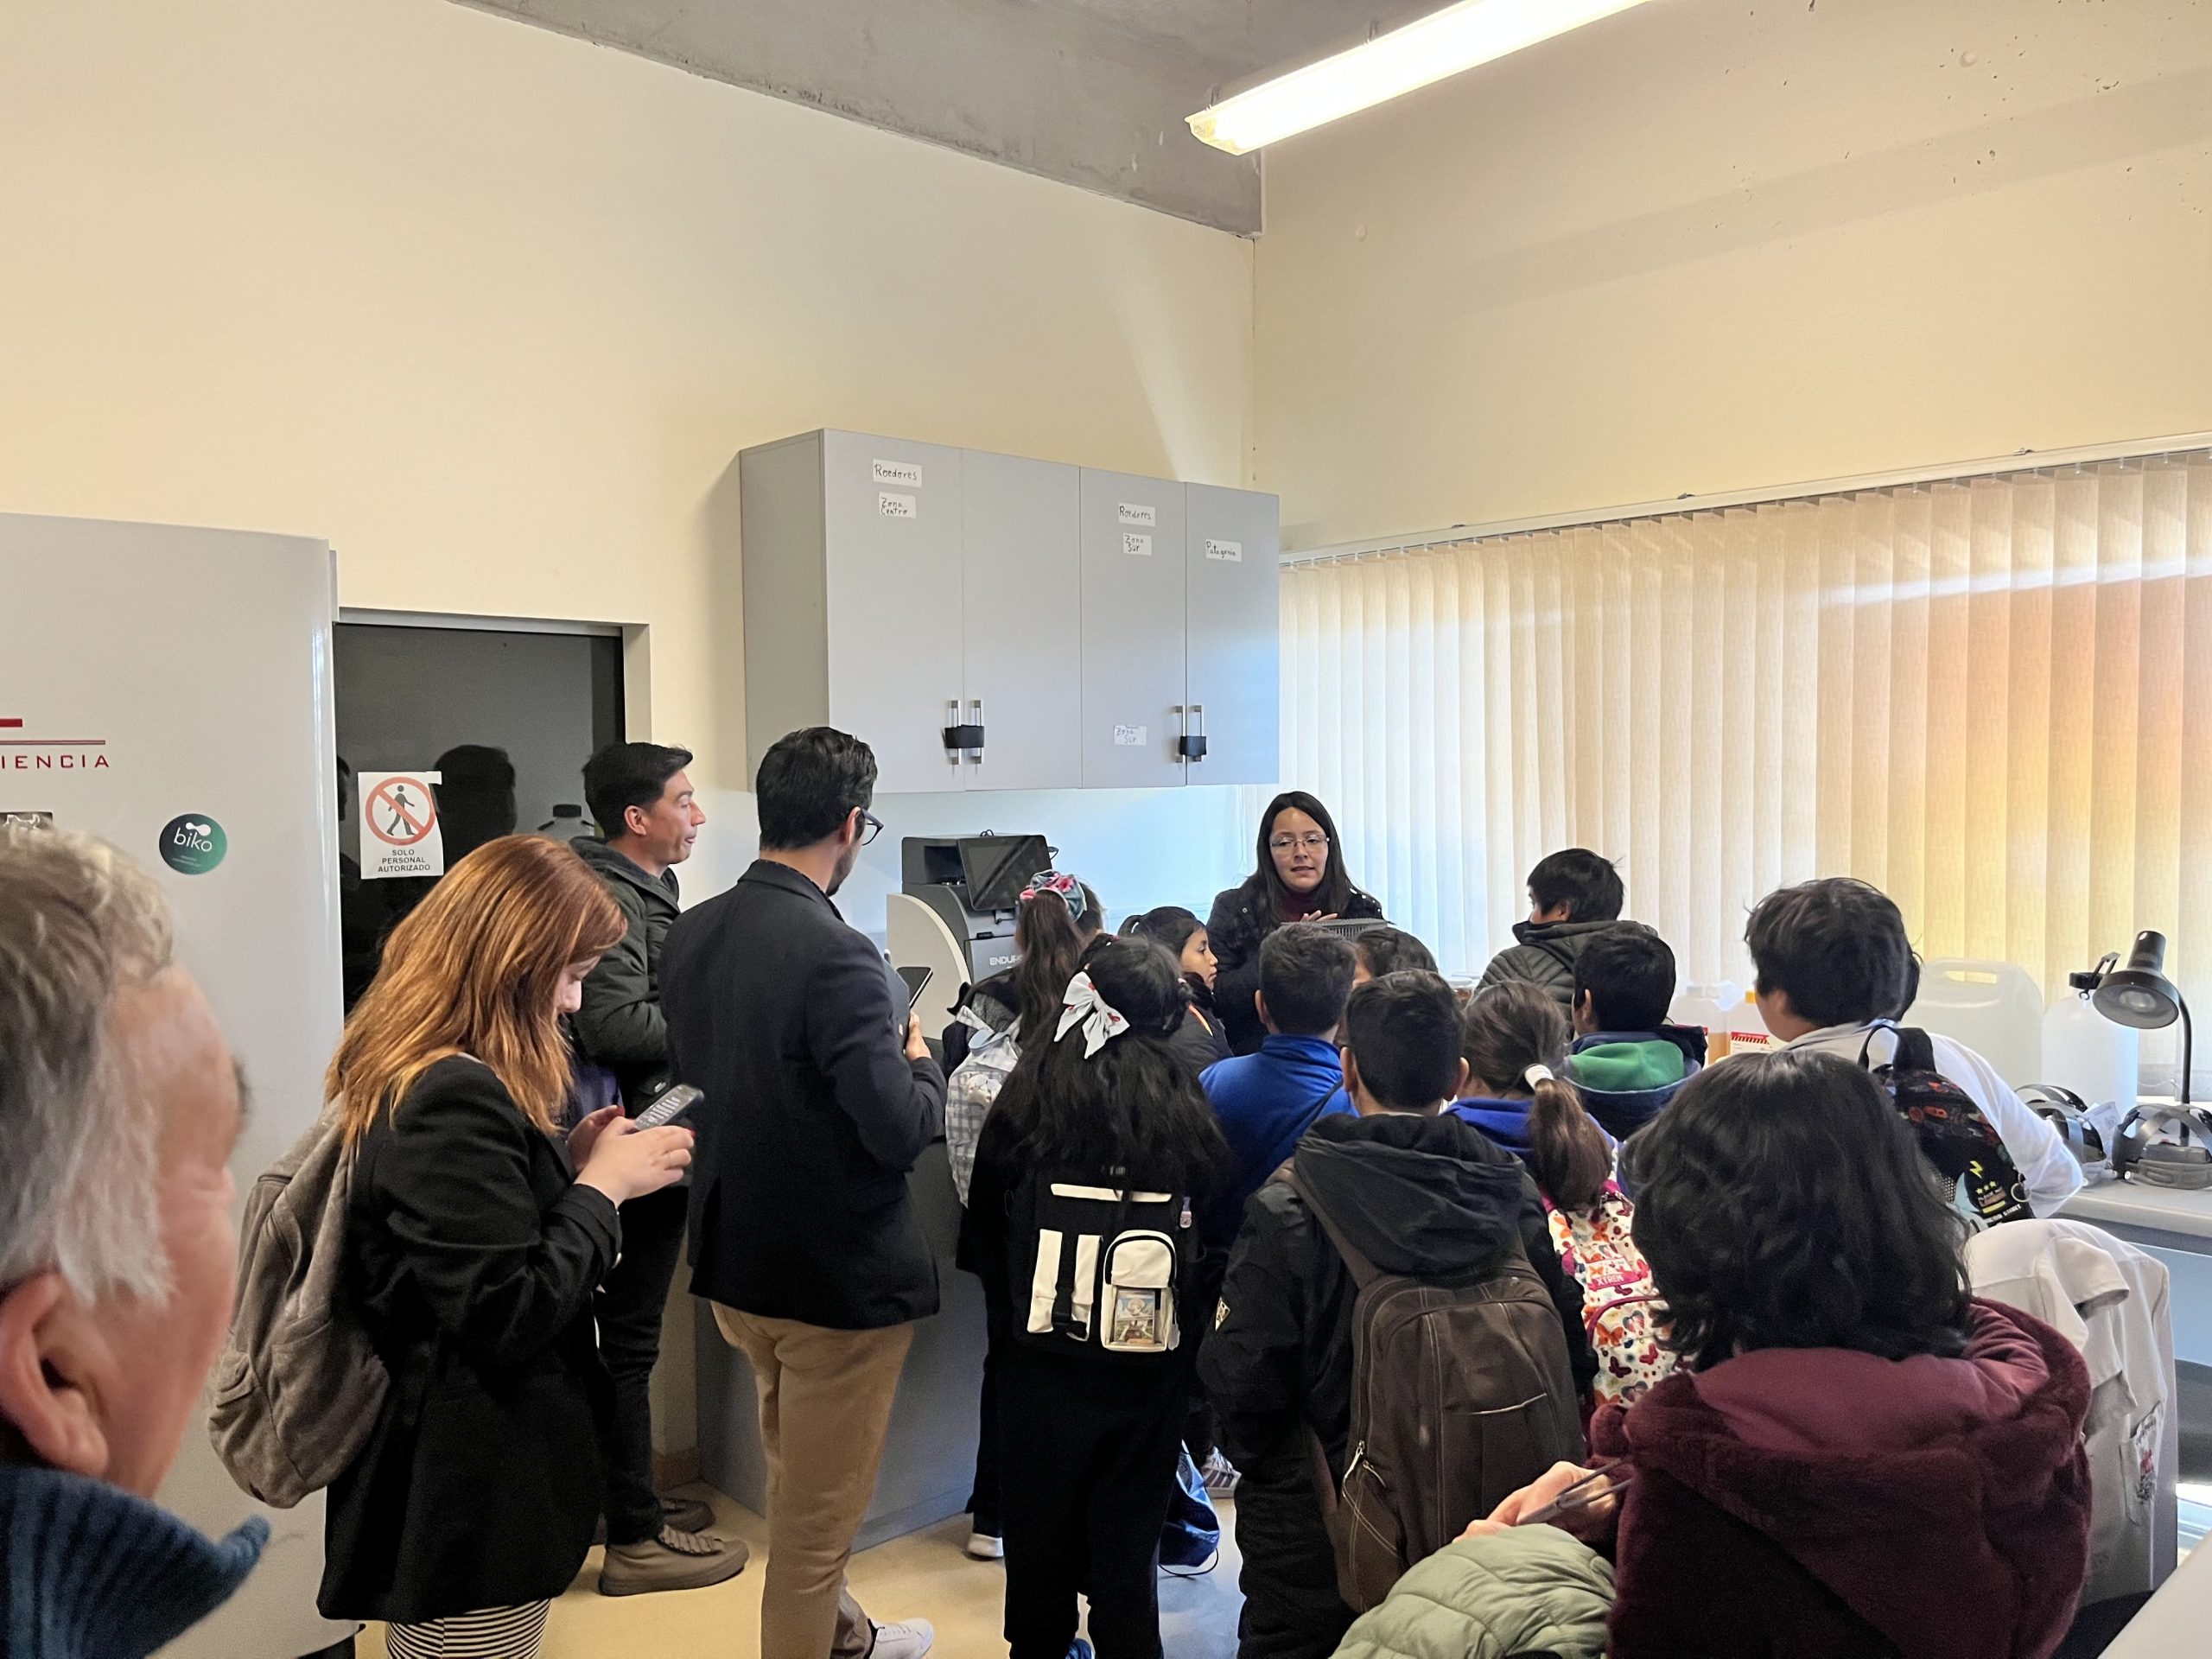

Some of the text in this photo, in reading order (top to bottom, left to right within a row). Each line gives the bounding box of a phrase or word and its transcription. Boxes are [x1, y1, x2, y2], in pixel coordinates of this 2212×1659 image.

[874, 464, 917, 481] Roedores
[881, 498, 902, 508] Zona
[880, 506, 908, 516] Centro
[174, 827, 213, 852] biko
[378, 864, 430, 873] AUTORIZADO
